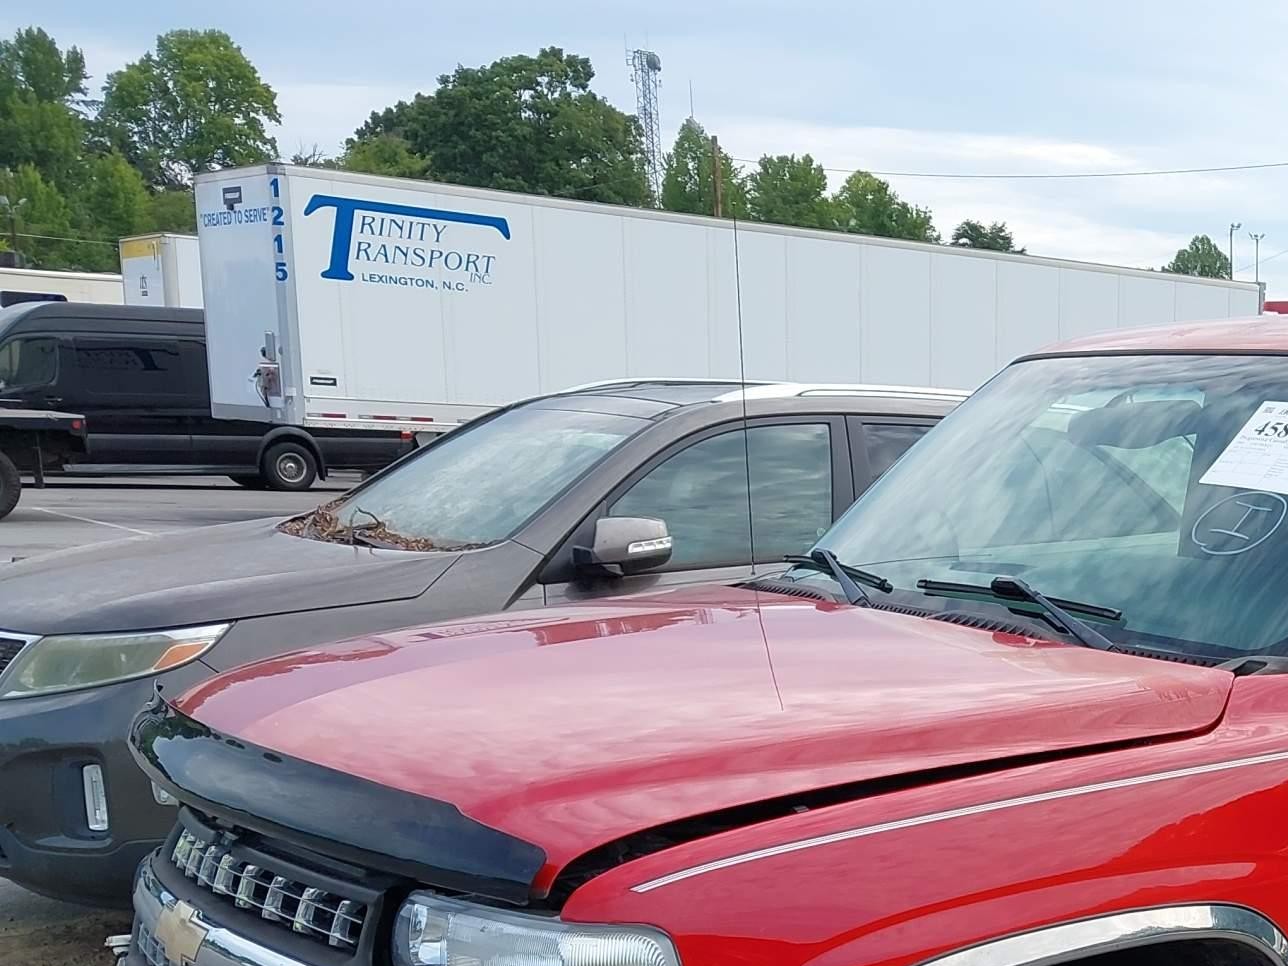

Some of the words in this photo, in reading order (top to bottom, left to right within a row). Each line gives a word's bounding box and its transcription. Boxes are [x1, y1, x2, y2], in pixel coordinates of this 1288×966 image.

[233, 209, 242, 223] TO
[361, 273, 439, 290] LEXINGTON,
[442, 281, 469, 292] N.C.
